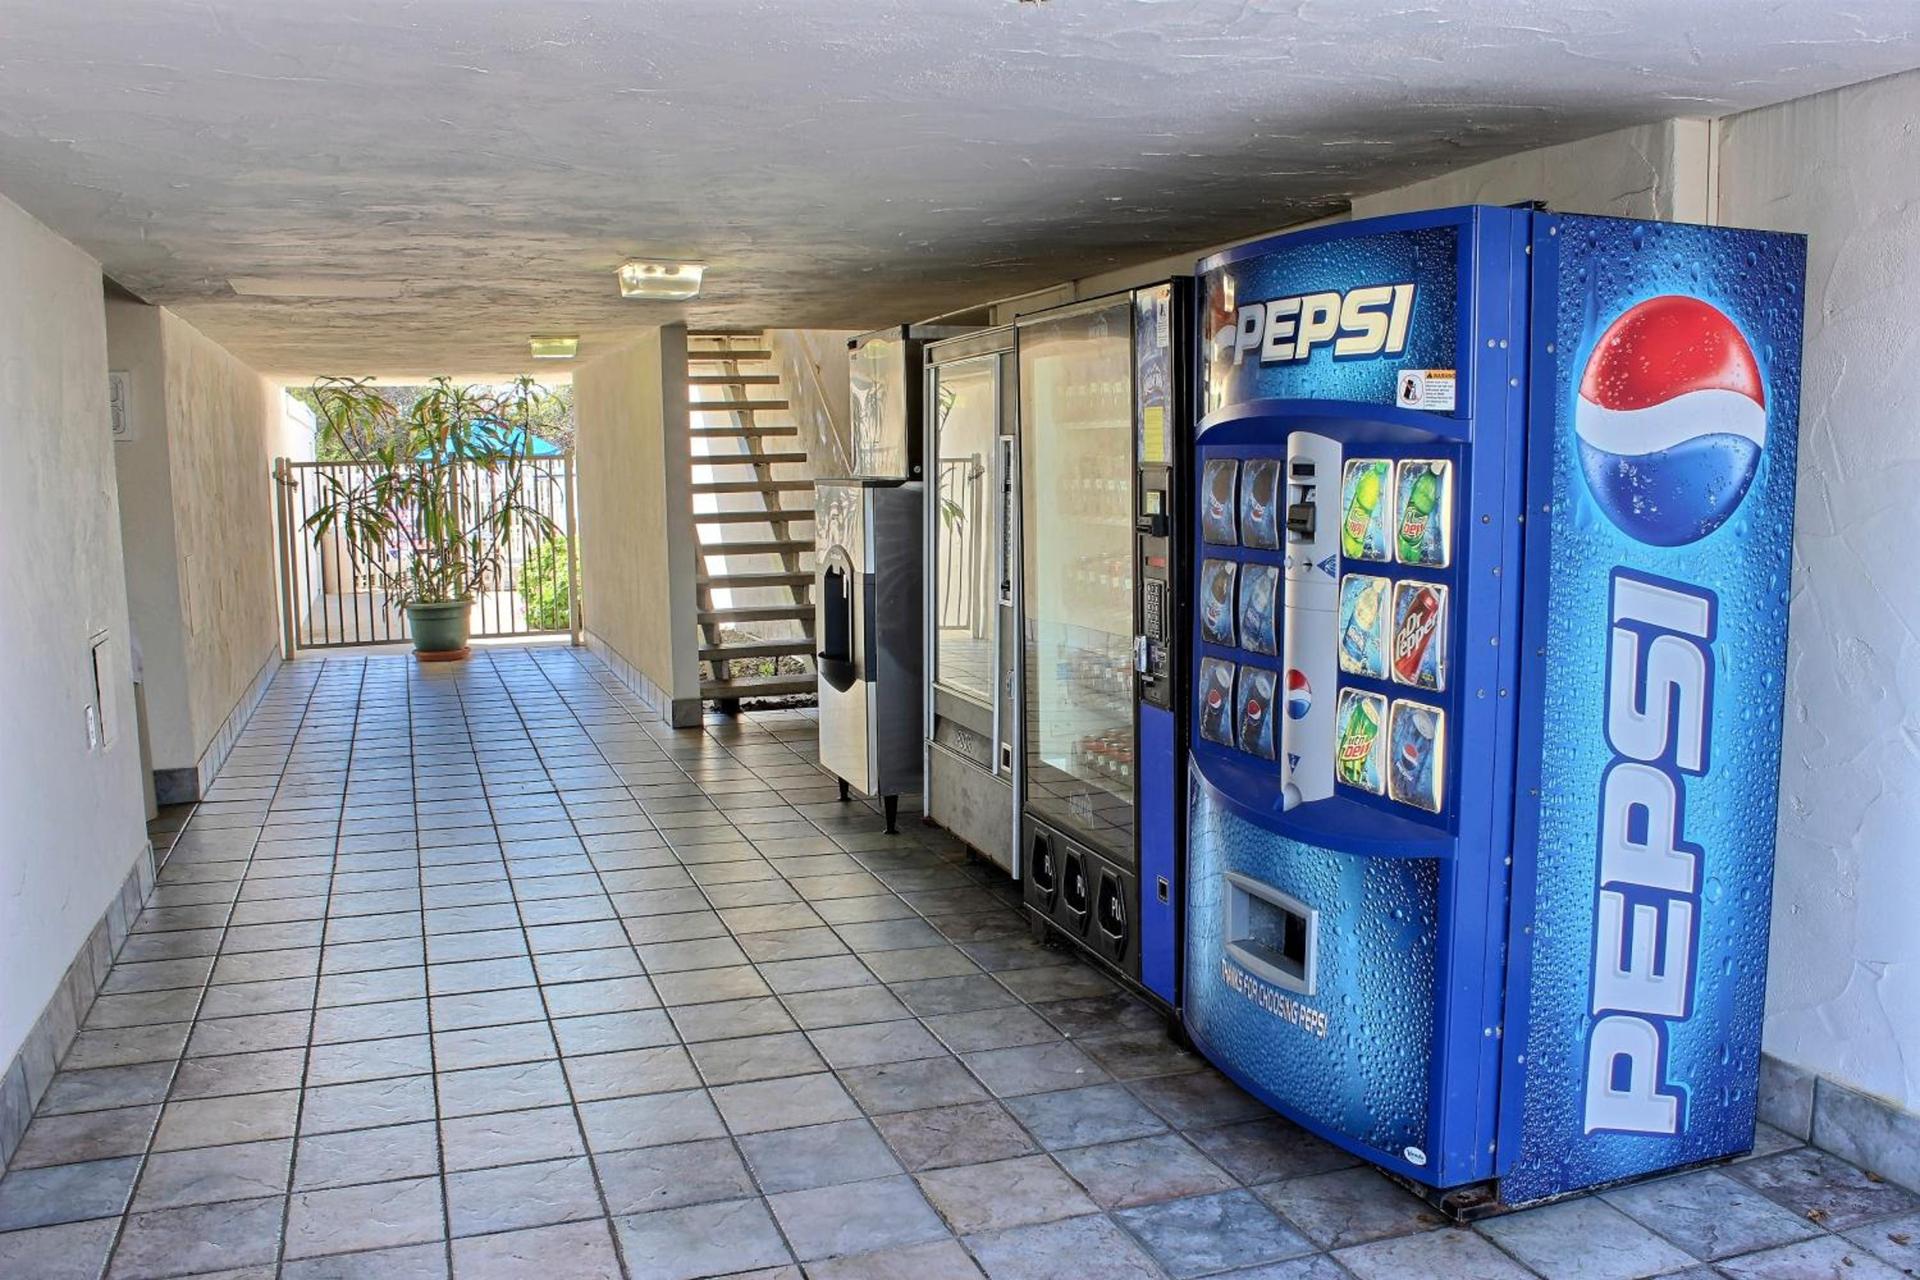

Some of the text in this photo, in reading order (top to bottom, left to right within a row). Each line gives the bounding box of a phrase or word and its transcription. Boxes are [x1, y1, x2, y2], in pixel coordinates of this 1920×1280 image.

[1233, 284, 1416, 365] PEPSI
[1407, 612, 1423, 636] Dr
[1584, 576, 1709, 1135] PEPSI
[1299, 1004, 1328, 1038] PEPSI
